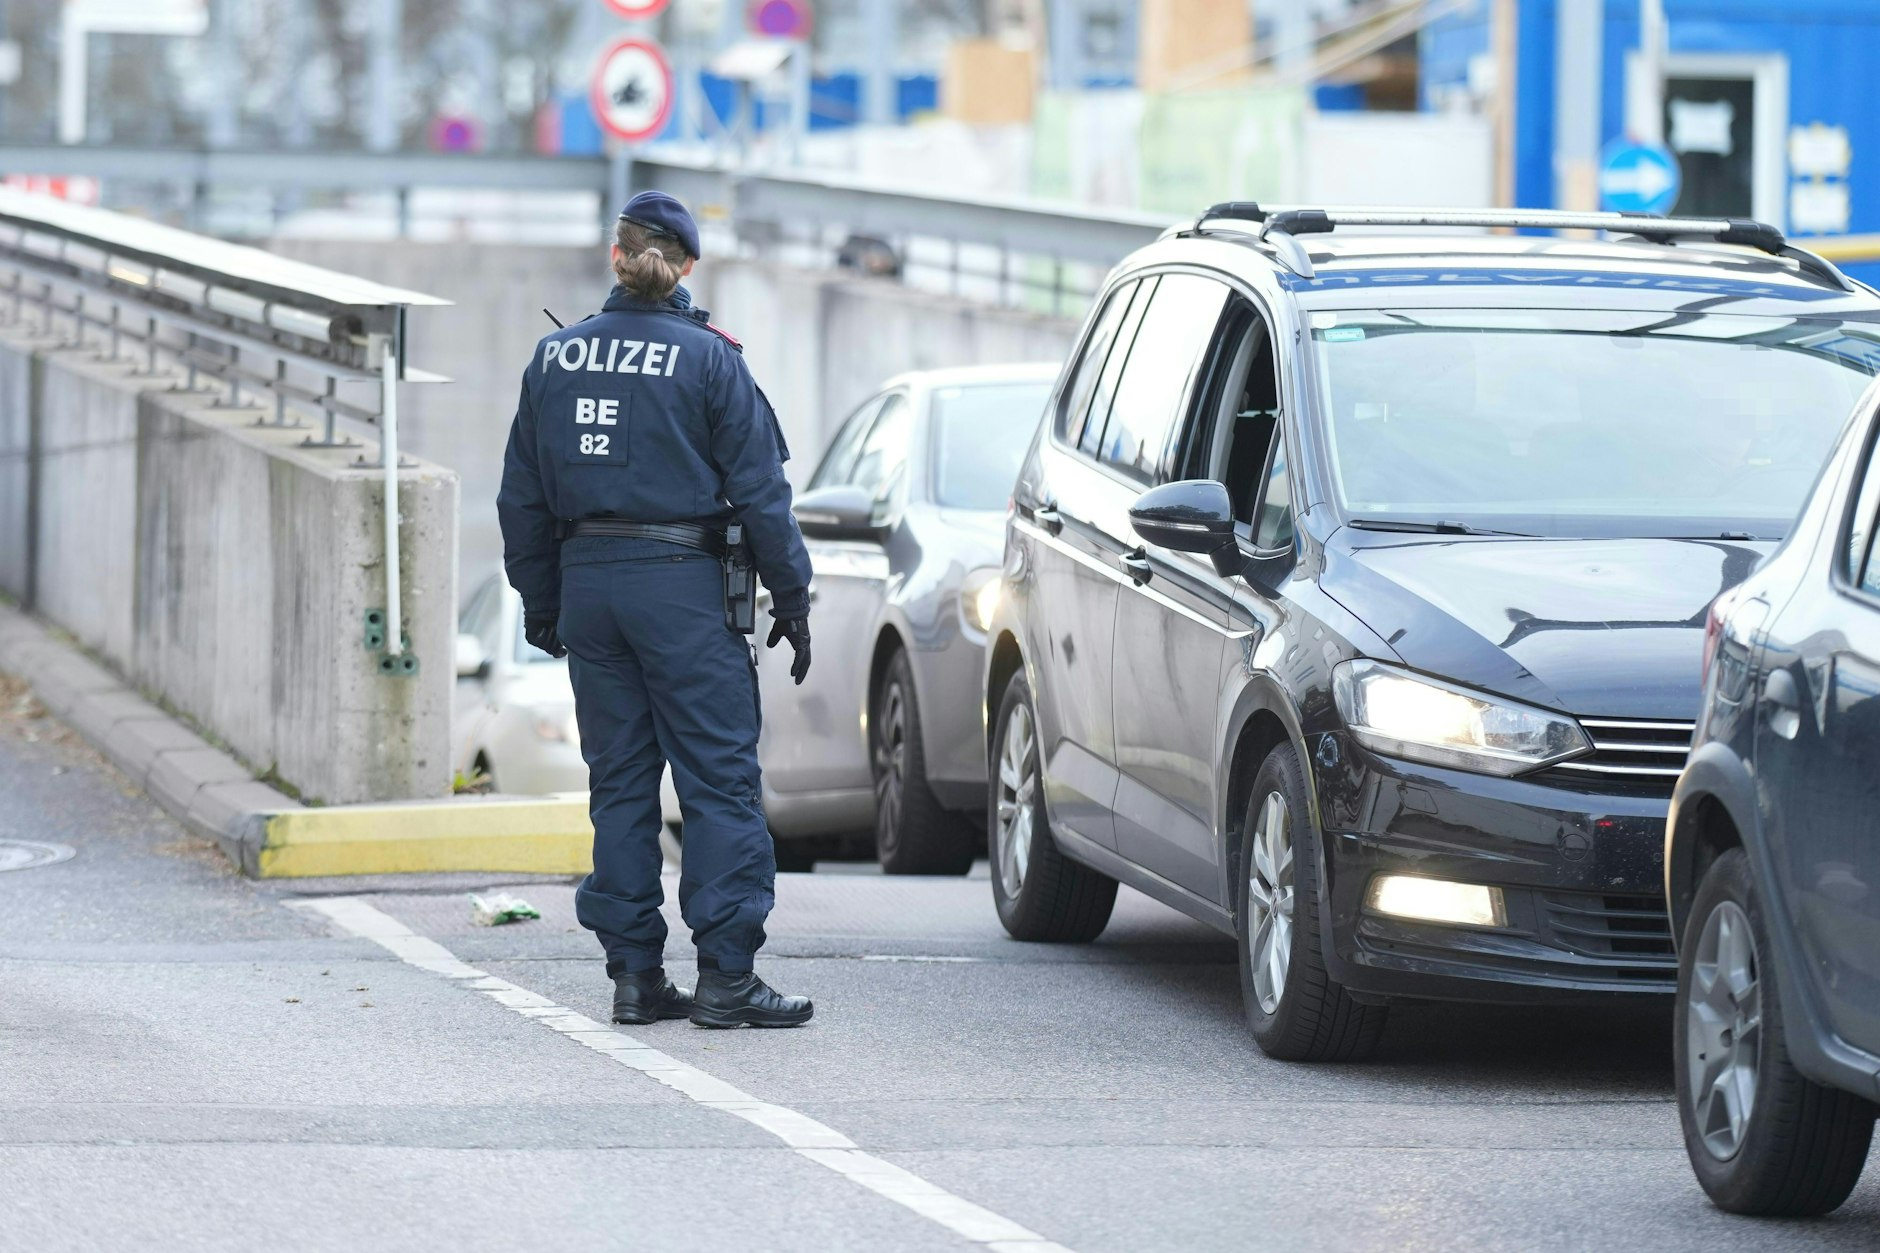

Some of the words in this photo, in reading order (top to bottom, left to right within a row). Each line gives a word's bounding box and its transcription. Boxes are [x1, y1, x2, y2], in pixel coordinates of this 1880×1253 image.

[542, 337, 680, 377] POLIZEI
[575, 398, 620, 426] BE
[579, 433, 610, 455] 82
